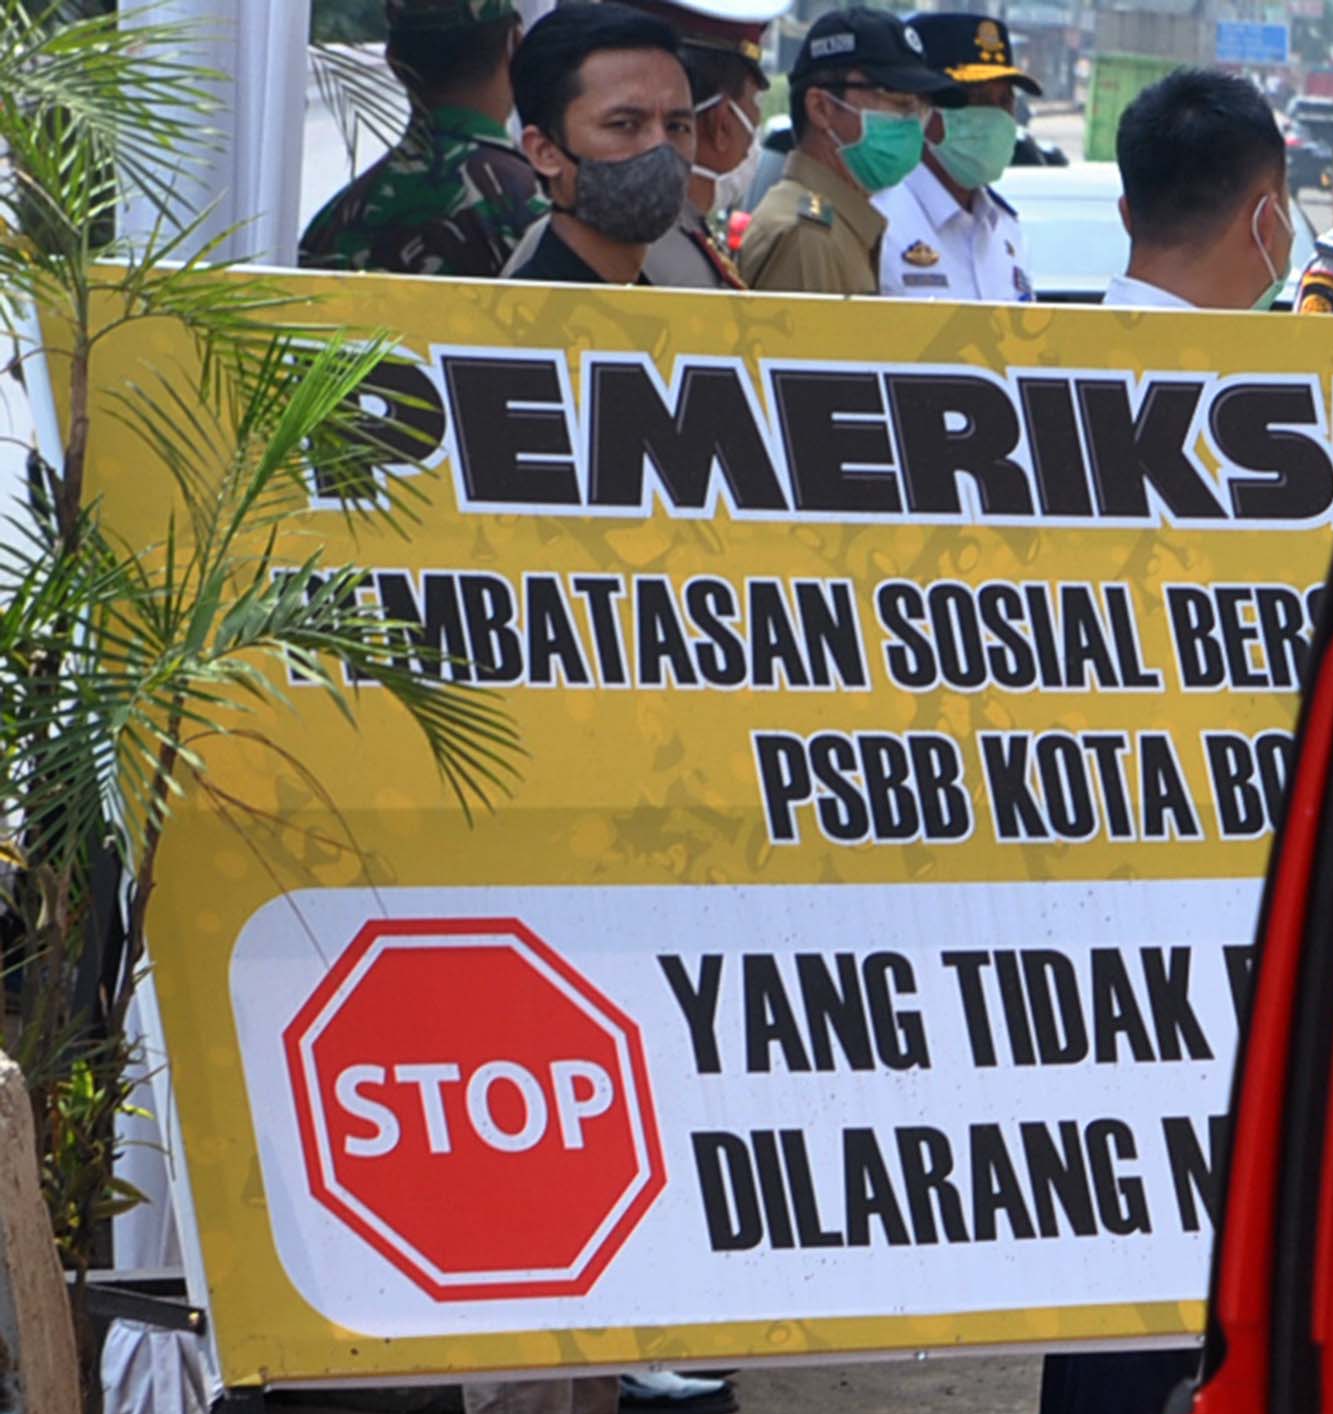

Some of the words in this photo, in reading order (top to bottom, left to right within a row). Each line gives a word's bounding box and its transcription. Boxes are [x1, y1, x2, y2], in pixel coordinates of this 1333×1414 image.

[876, 579, 1164, 692] SOSIAL
[751, 731, 975, 846] PSBB
[977, 731, 1204, 844] KOTA
[657, 951, 931, 1074] YANG
[941, 946, 1214, 1067] TIDAK
[334, 1059, 614, 1157] STOP
[691, 1118, 1152, 1252] DILARANG
